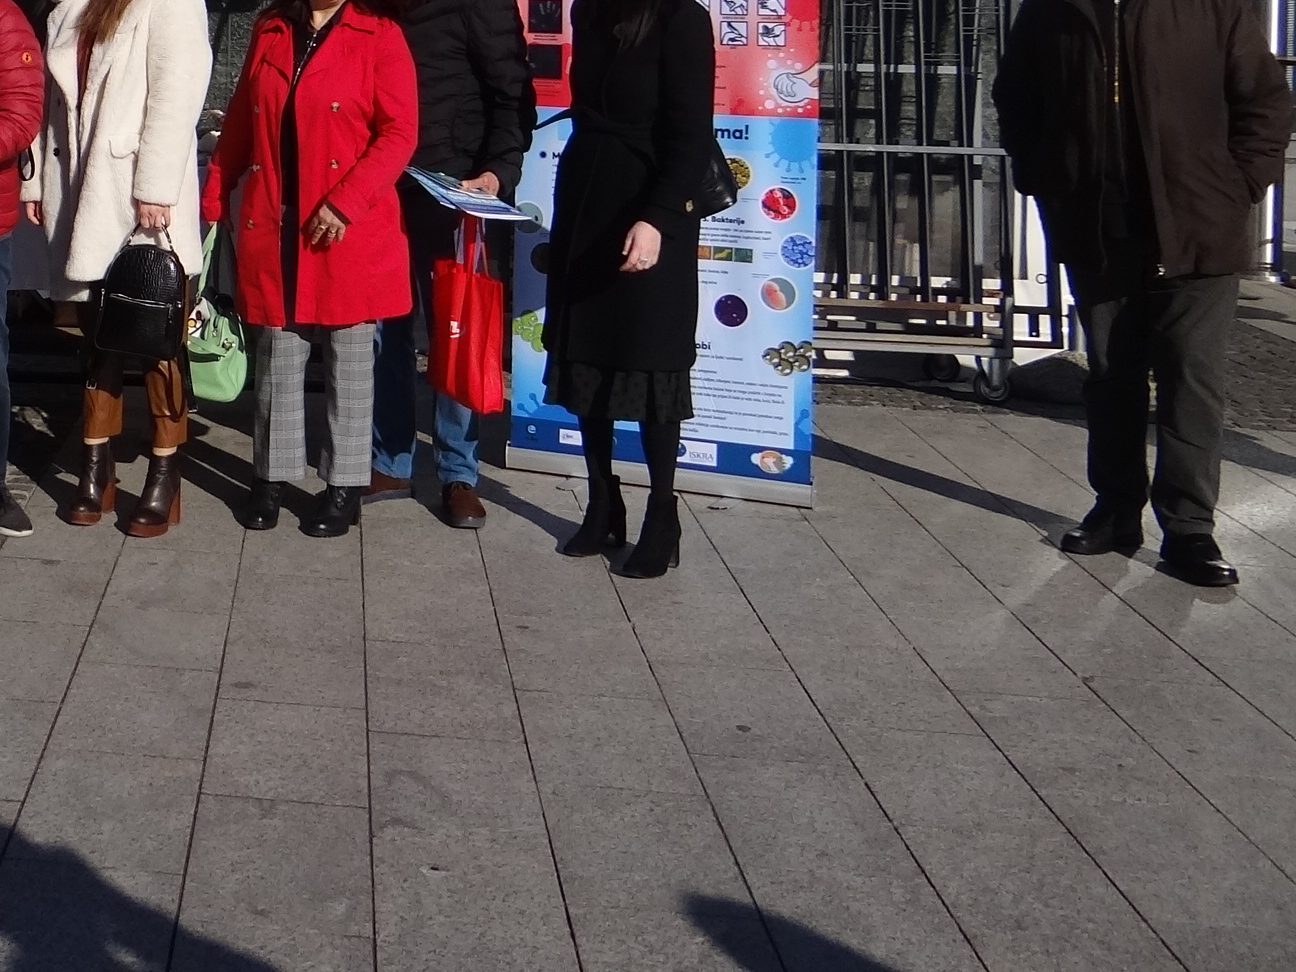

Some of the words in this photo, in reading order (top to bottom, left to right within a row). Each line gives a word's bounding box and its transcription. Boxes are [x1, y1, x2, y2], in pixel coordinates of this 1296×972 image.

[714, 124, 750, 140] ma!
[711, 215, 746, 226] Bakterije
[694, 341, 712, 351] obi
[688, 451, 714, 462] ISKRA
